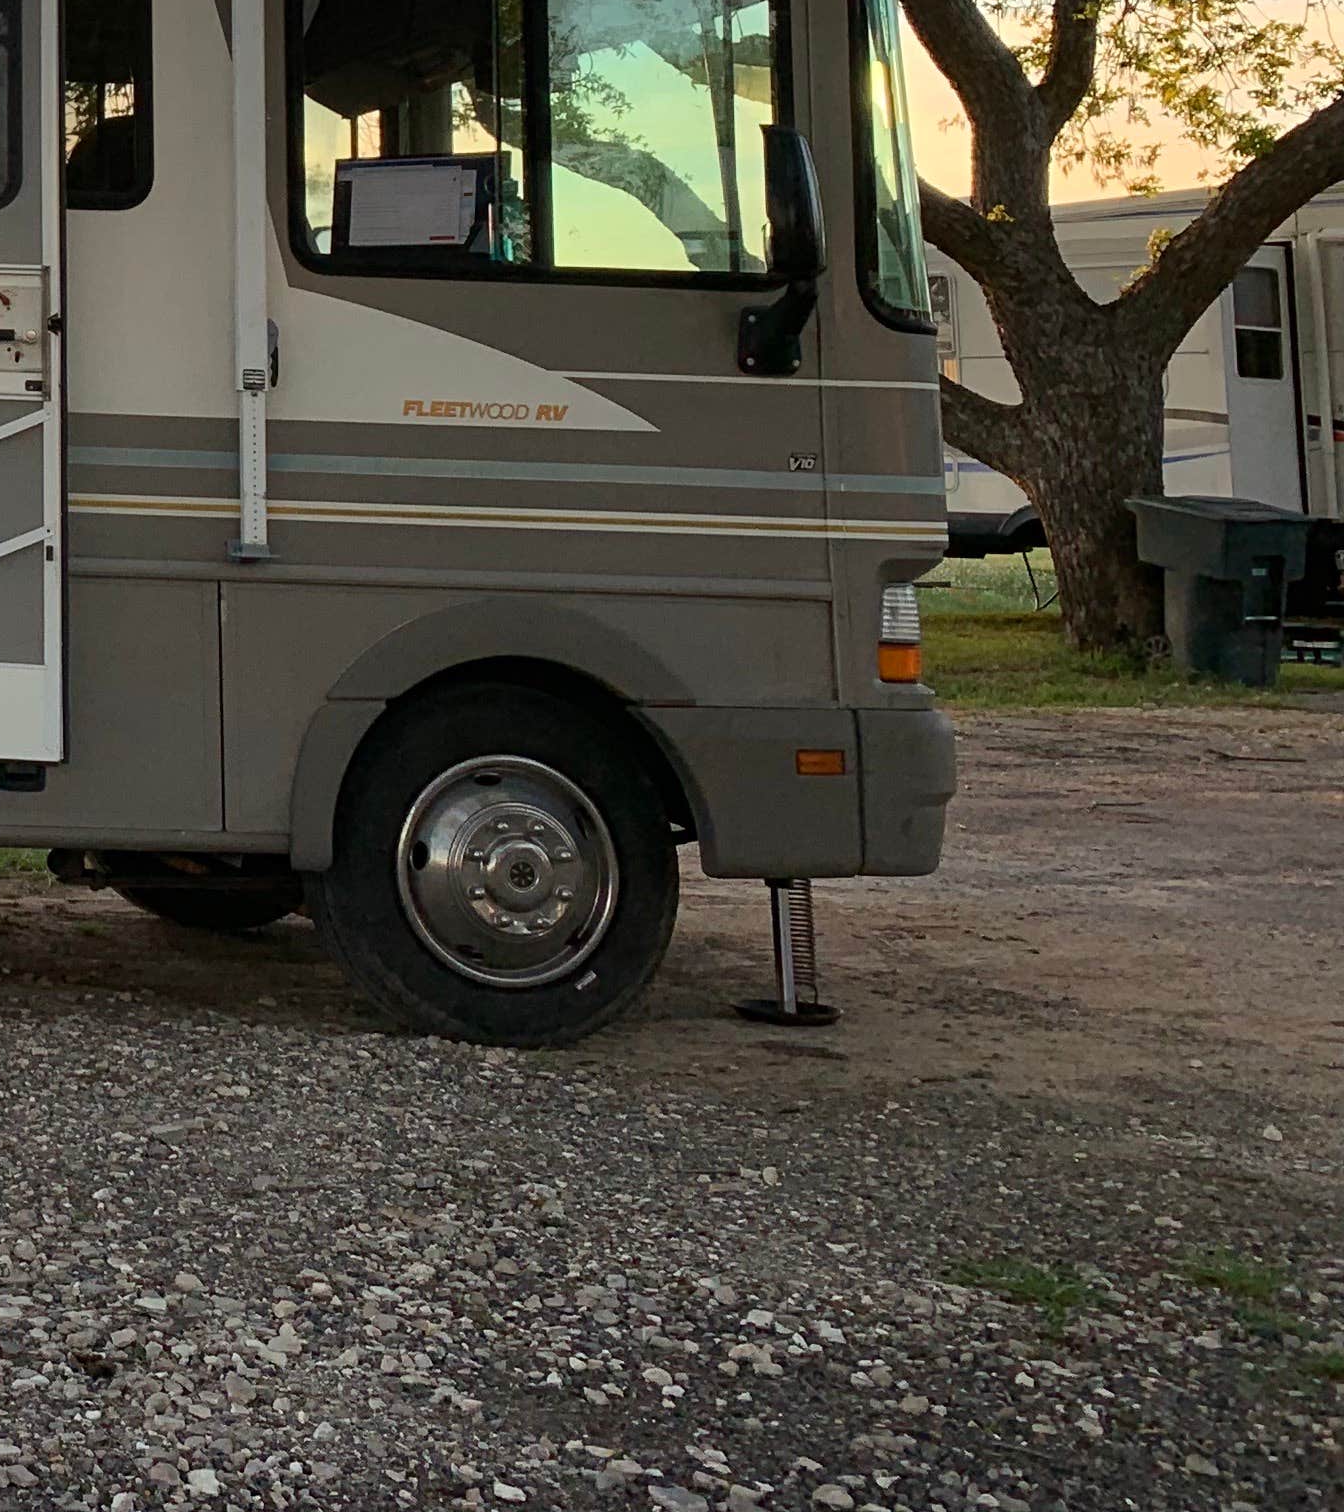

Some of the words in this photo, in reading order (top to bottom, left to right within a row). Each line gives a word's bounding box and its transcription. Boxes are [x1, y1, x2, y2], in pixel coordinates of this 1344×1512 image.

[402, 399, 530, 420] FLEETWOOD
[535, 404, 569, 422] RV
[789, 456, 816, 471] V10
